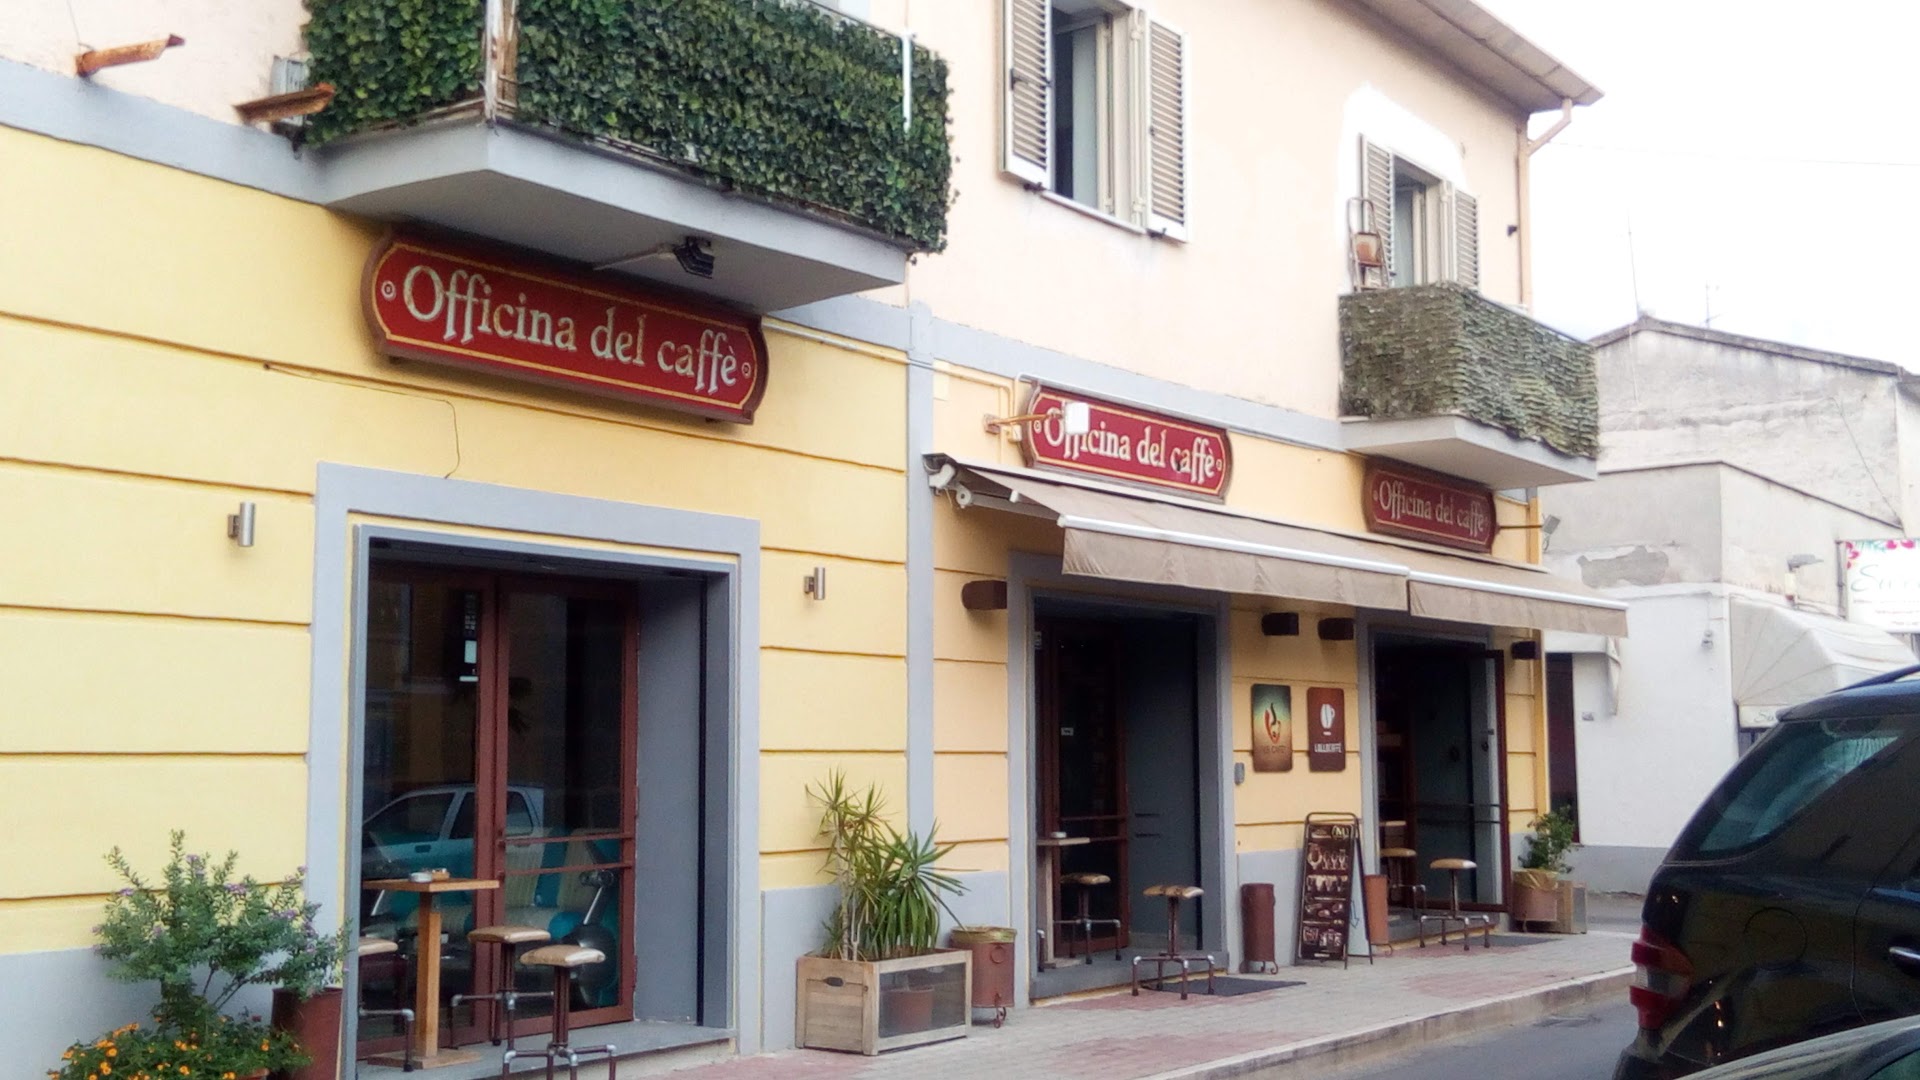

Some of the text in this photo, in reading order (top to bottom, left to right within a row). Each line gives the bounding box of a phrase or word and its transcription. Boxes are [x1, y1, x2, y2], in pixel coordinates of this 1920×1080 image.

[403, 265, 738, 395] Officina del caffè
[1137, 425, 1166, 468] del
[1170, 436, 1215, 484] caffè
[1379, 480, 1432, 521] Officina
[1435, 493, 1454, 525] del
